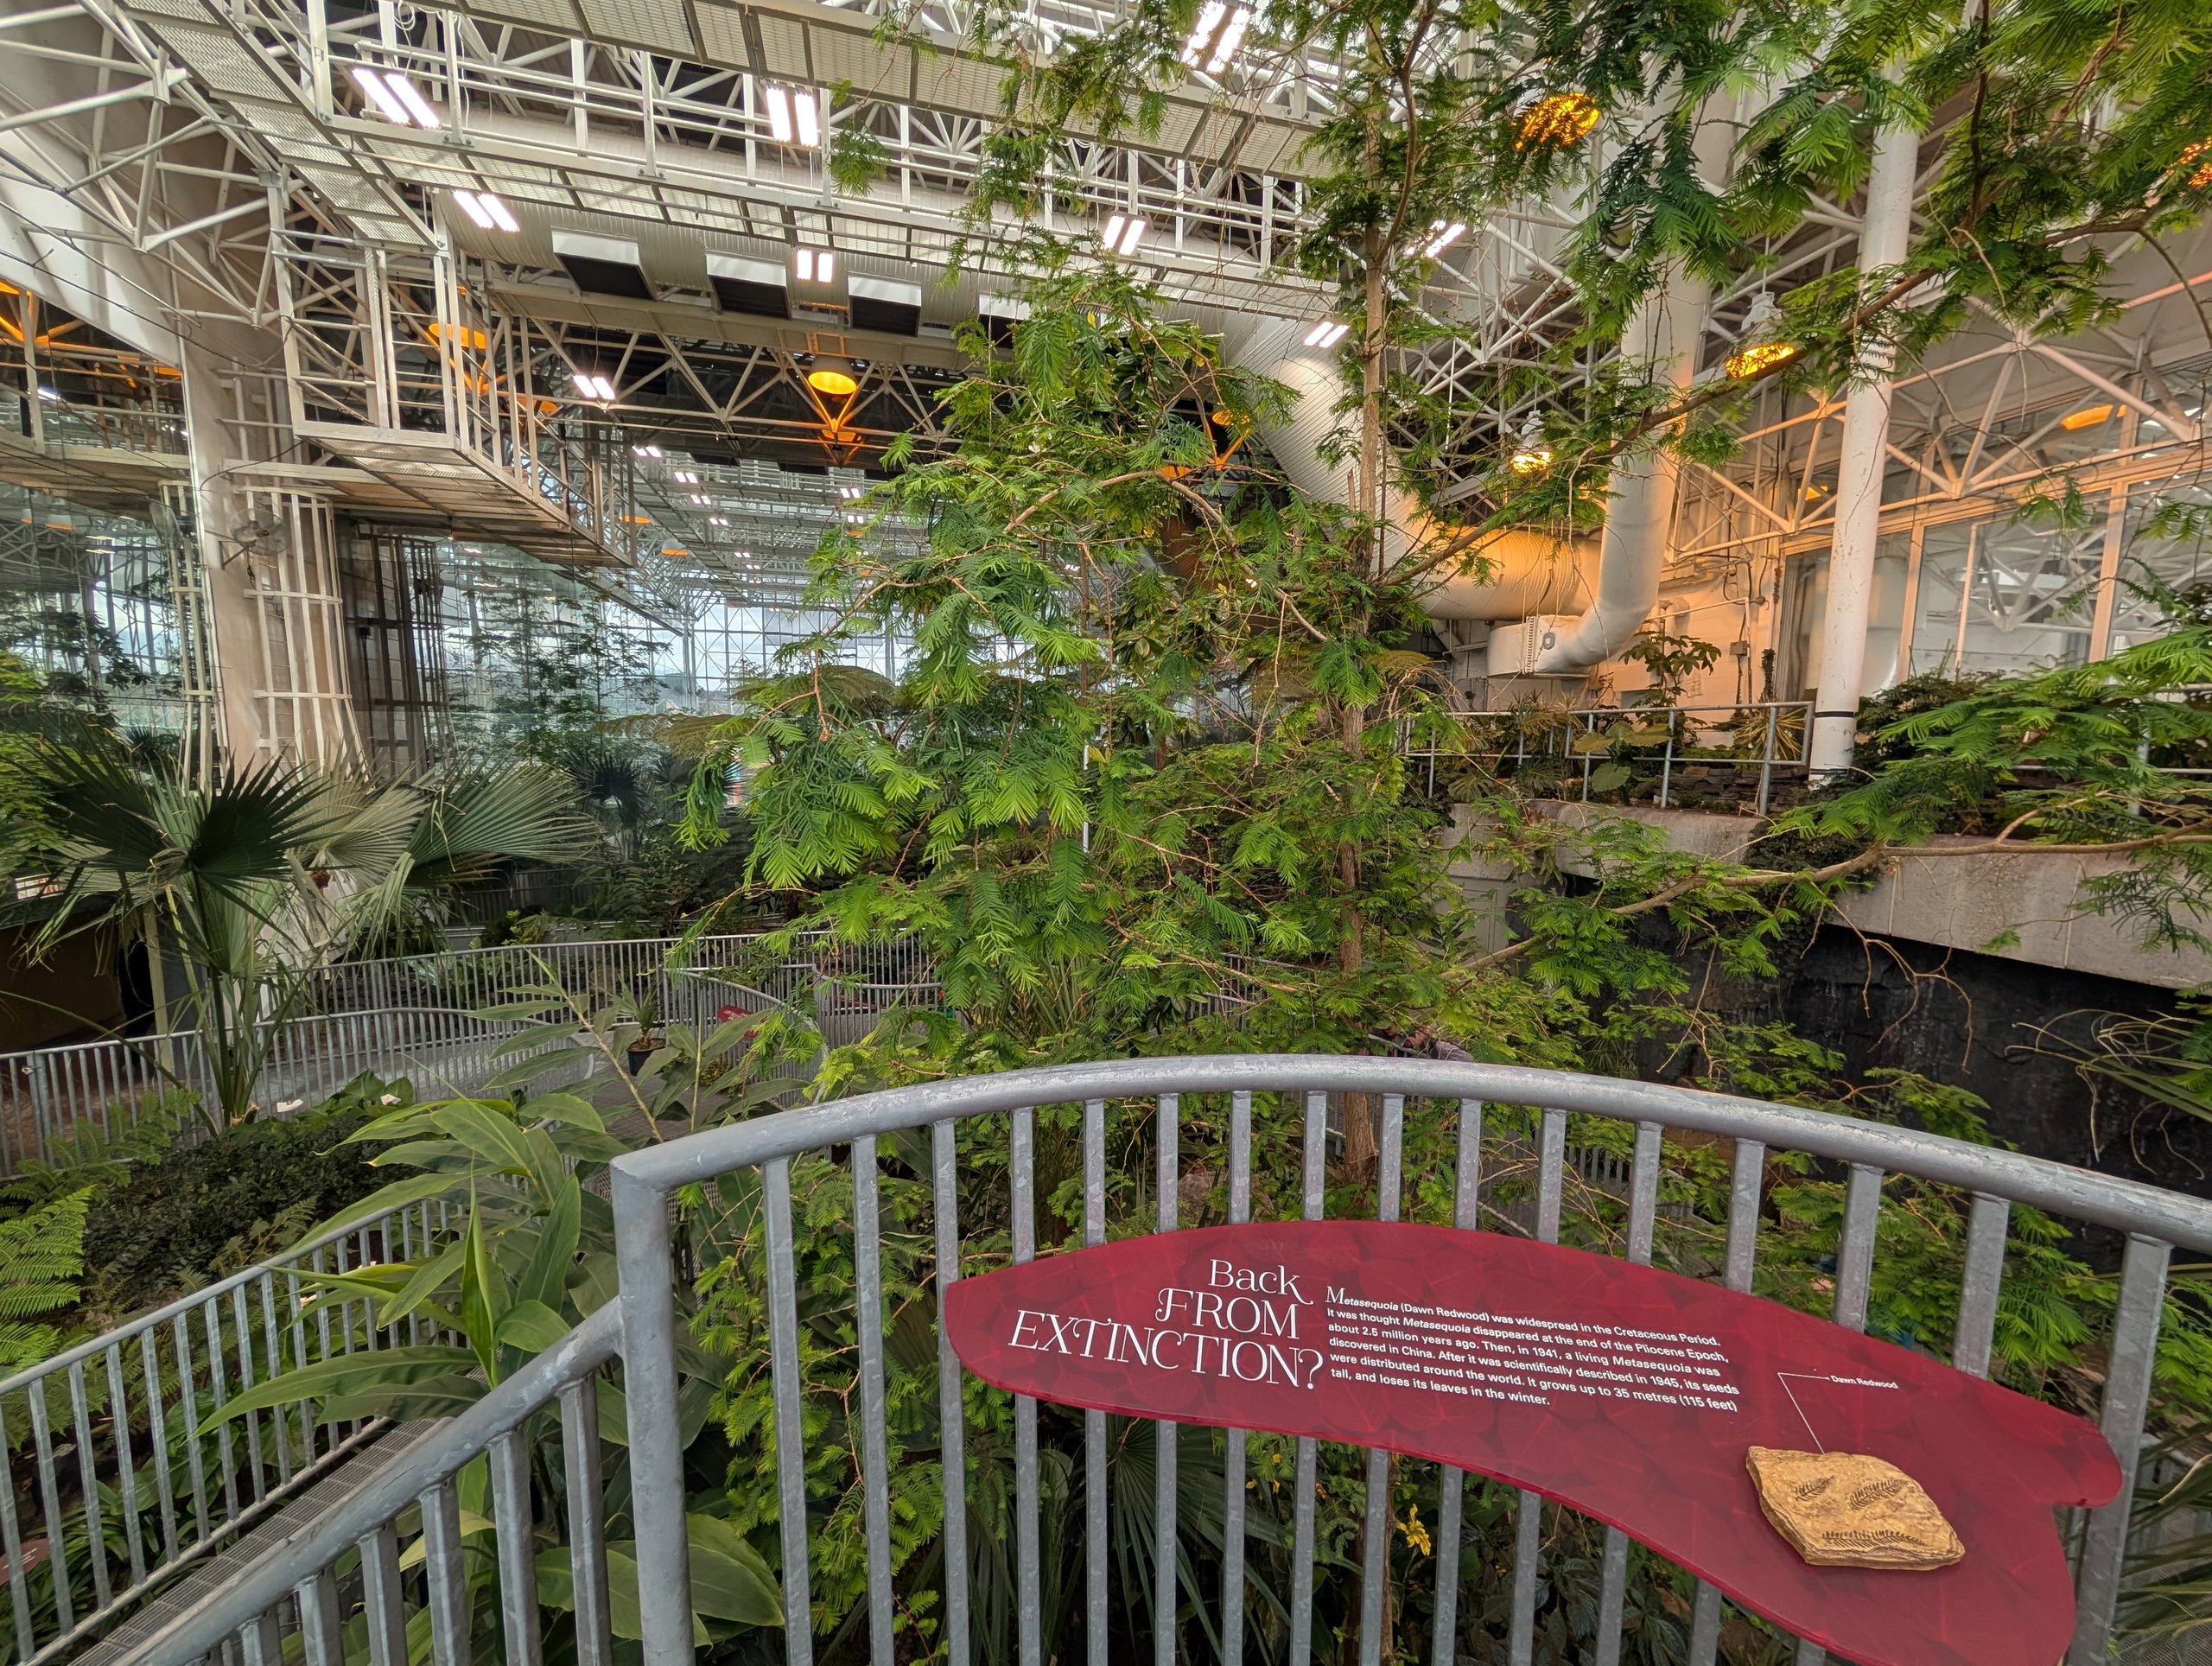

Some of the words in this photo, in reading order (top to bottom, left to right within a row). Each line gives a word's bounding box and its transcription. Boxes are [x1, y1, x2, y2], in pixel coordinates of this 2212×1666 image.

[1208, 1259, 1313, 1305] Back
[1155, 1288, 1300, 1339] FROM
[1325, 1286, 1399, 1311] Metasequoia
[1401, 1302, 1434, 1315] (Dawn
[1436, 1307, 1490, 1322] Redwood)
[1491, 1315, 1514, 1324] was
[1515, 1317, 1579, 1332] widespread
[1580, 1323, 1592, 1332] in
[1592, 1325, 1612, 1335] the
[1613, 1326, 1678, 1341] Cretaceous
[1678, 1333, 1721, 1346] Period.
[1327, 1307, 1334, 1317] It
[1336, 1311, 1357, 1319] was
[1359, 1312, 1401, 1326] thought
[1403, 1317, 1471, 1333] Metasequoia
[1472, 1326, 1540, 1341] disappeared
[1541, 1334, 1554, 1343] at
[1554, 1335, 1573, 1345] the
[1575, 1339, 1599, 1348] end
[1600, 1340, 1611, 1349] of
[1613, 1341, 1633, 1351] the
[1635, 1343, 1686, 1358] Pliocene
[1686, 1348, 1729, 1363] Epoch,
[1007, 1310, 1323, 1389] EXTINCTION?
[1328, 1323, 1359, 1334] about
[1362, 1326, 1378, 1337] 2.5
[1382, 1330, 1419, 1342] million
[1421, 1335, 1452, 1346] years
[1455, 1339, 1479, 1350] ago.
[1481, 1340, 1515, 1354] Then,
[1517, 1345, 1529, 1355] in
[1532, 1347, 1562, 1360] 1941,
[1574, 1351, 1610, 1366] living
[1612, 1356, 1692, 1373] Metasequoia
[1694, 1366, 1720, 1377] was
[1329, 1337, 1386, 1352] discovered
[1389, 1344, 1399, 1354] in
[1402, 1345, 1436, 1359] China.
[1438, 1351, 1465, 1363] After
[1467, 1354, 1477, 1364] it
[1478, 1358, 1502, 1367] was
[1503, 1359, 1573, 1377] scientifically
[1575, 1367, 1634, 1383] described
[1634, 1374, 1649, 1384] in
[1649, 1376, 1683, 1389] 1945,
[1683, 1379, 1701, 1390] its
[1702, 1383, 1739, 1395] seeds
[1330, 1353, 1357, 1364] were
[1360, 1356, 1421, 1372] distributed
[1423, 1366, 1464, 1378] around
[1465, 1370, 1485, 1381] the
[1487, 1374, 1525, 1386] world.
[1527, 1377, 1537, 1387] It
[1539, 1381, 1577, 1392] grows
[1580, 1385, 1596, 1396] up
[1598, 1386, 1611, 1396] to
[1613, 1387, 1630, 1398] 35
[1632, 1391, 1677, 1404] metres
[1679, 1394, 1705, 1407] (115
[1706, 1397, 1738, 1412] feet)
[1331, 1368, 1351, 1380] tall,
[1355, 1372, 1376, 1383] and
[1379, 1374, 1410, 1387] loses
[1413, 1378, 1427, 1389] its
[1430, 1380, 1468, 1395] leaves
[1470, 1385, 1483, 1396] in
[1484, 1388, 1505, 1399] the
[1507, 1391, 1550, 1405] winter.
[1830, 1375, 1857, 1384] Dawn
[1856, 1377, 1898, 1389] Redwood
